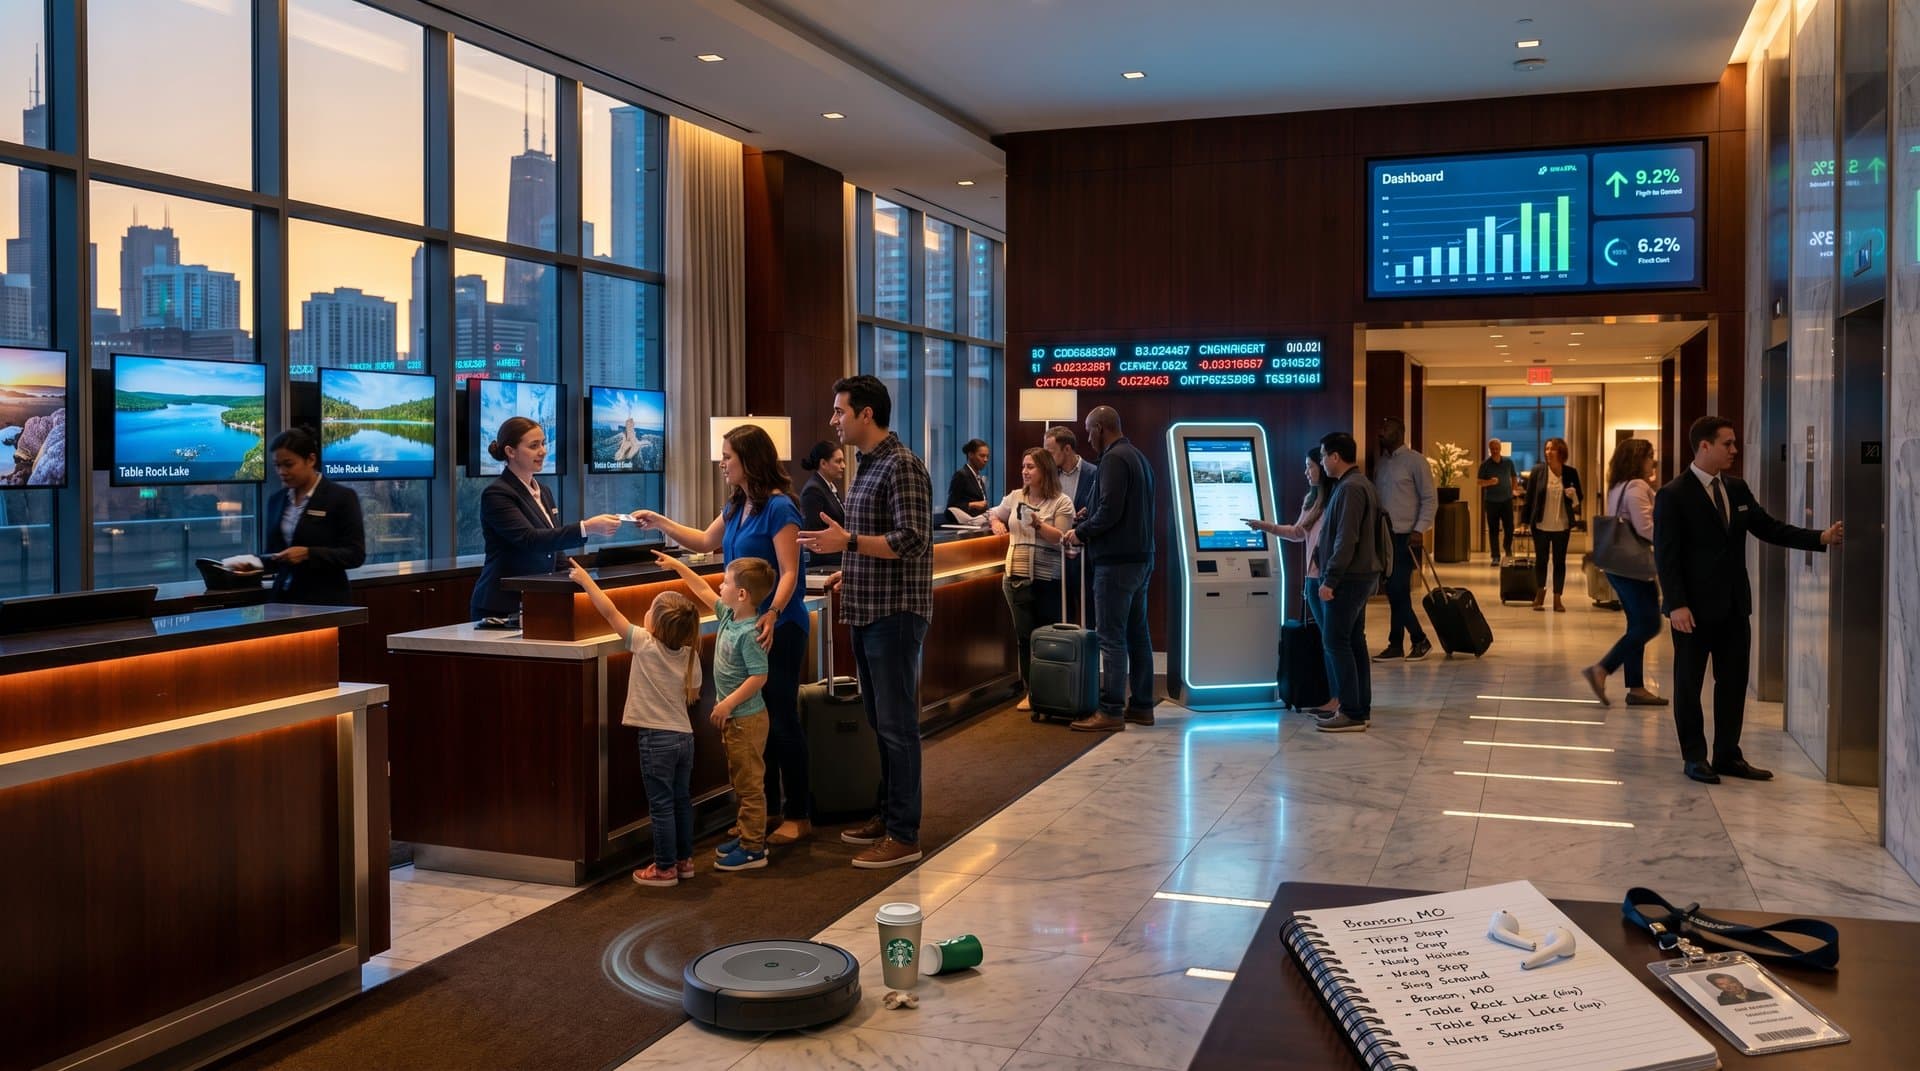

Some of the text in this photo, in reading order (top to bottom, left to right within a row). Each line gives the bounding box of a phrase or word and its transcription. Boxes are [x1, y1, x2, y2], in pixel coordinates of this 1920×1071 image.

[1382, 170, 1444, 184] Dashboard
[1636, 168, 1680, 185] 9.2%
[1638, 237, 1680, 253] 6.2%
[119, 465, 190, 477] Table Rock Lake
[325, 464, 379, 474] Table Rock Lake
[1343, 908, 1445, 928] Branson, MO
[1437, 963, 1469, 972] Stop
[1410, 985, 1495, 1003] Branson, MO
[1420, 1006, 1464, 1017] Table
[1470, 999, 1507, 1010] Rock
[1512, 993, 1550, 1004] Lake
[1430, 1020, 1475, 1031] Table
[1480, 1012, 1522, 1024] Rock
[1528, 1005, 1569, 1017] Lake
